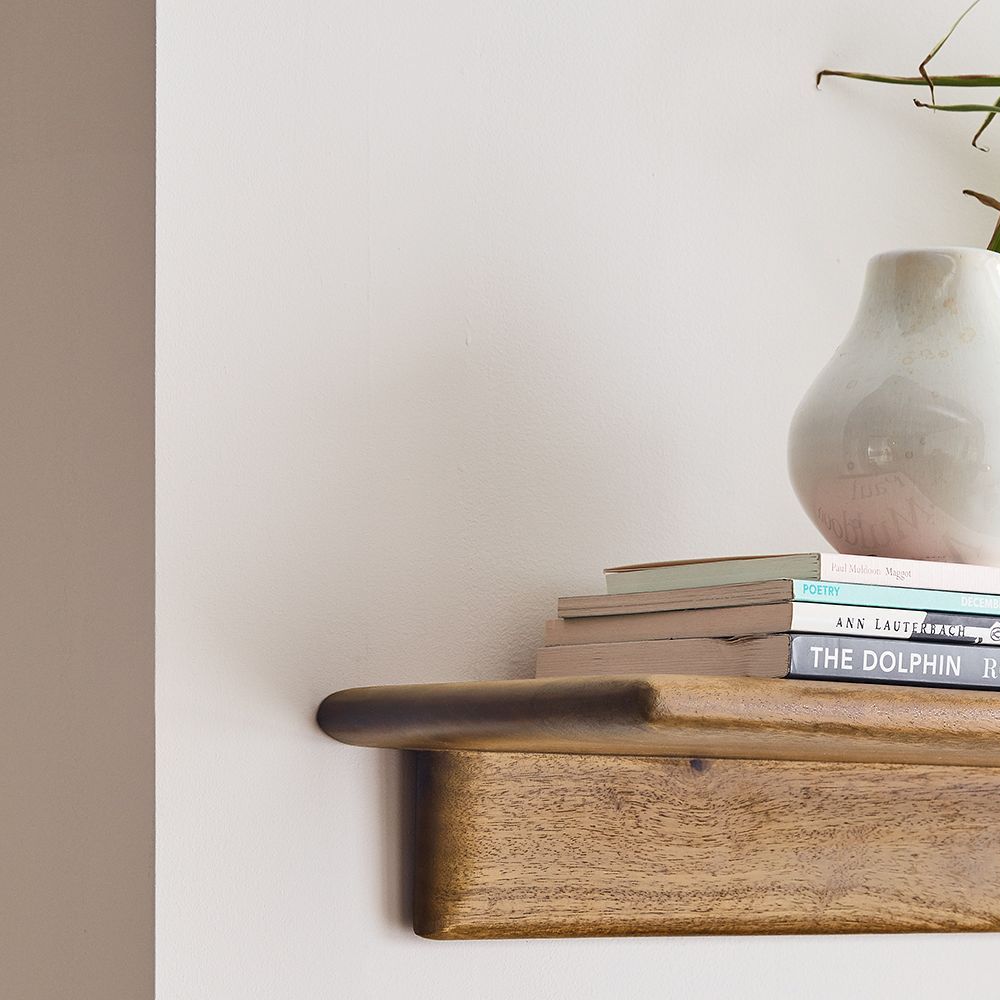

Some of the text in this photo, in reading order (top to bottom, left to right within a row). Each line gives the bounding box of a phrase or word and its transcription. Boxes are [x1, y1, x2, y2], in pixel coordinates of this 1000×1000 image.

[831, 563, 881, 576] Paul Muldoon
[886, 567, 912, 581] Maggot
[803, 584, 840, 597] POETRY
[836, 617, 966, 638] ANN LAUTERBACH
[810, 646, 961, 677] THE DOLPHIN
